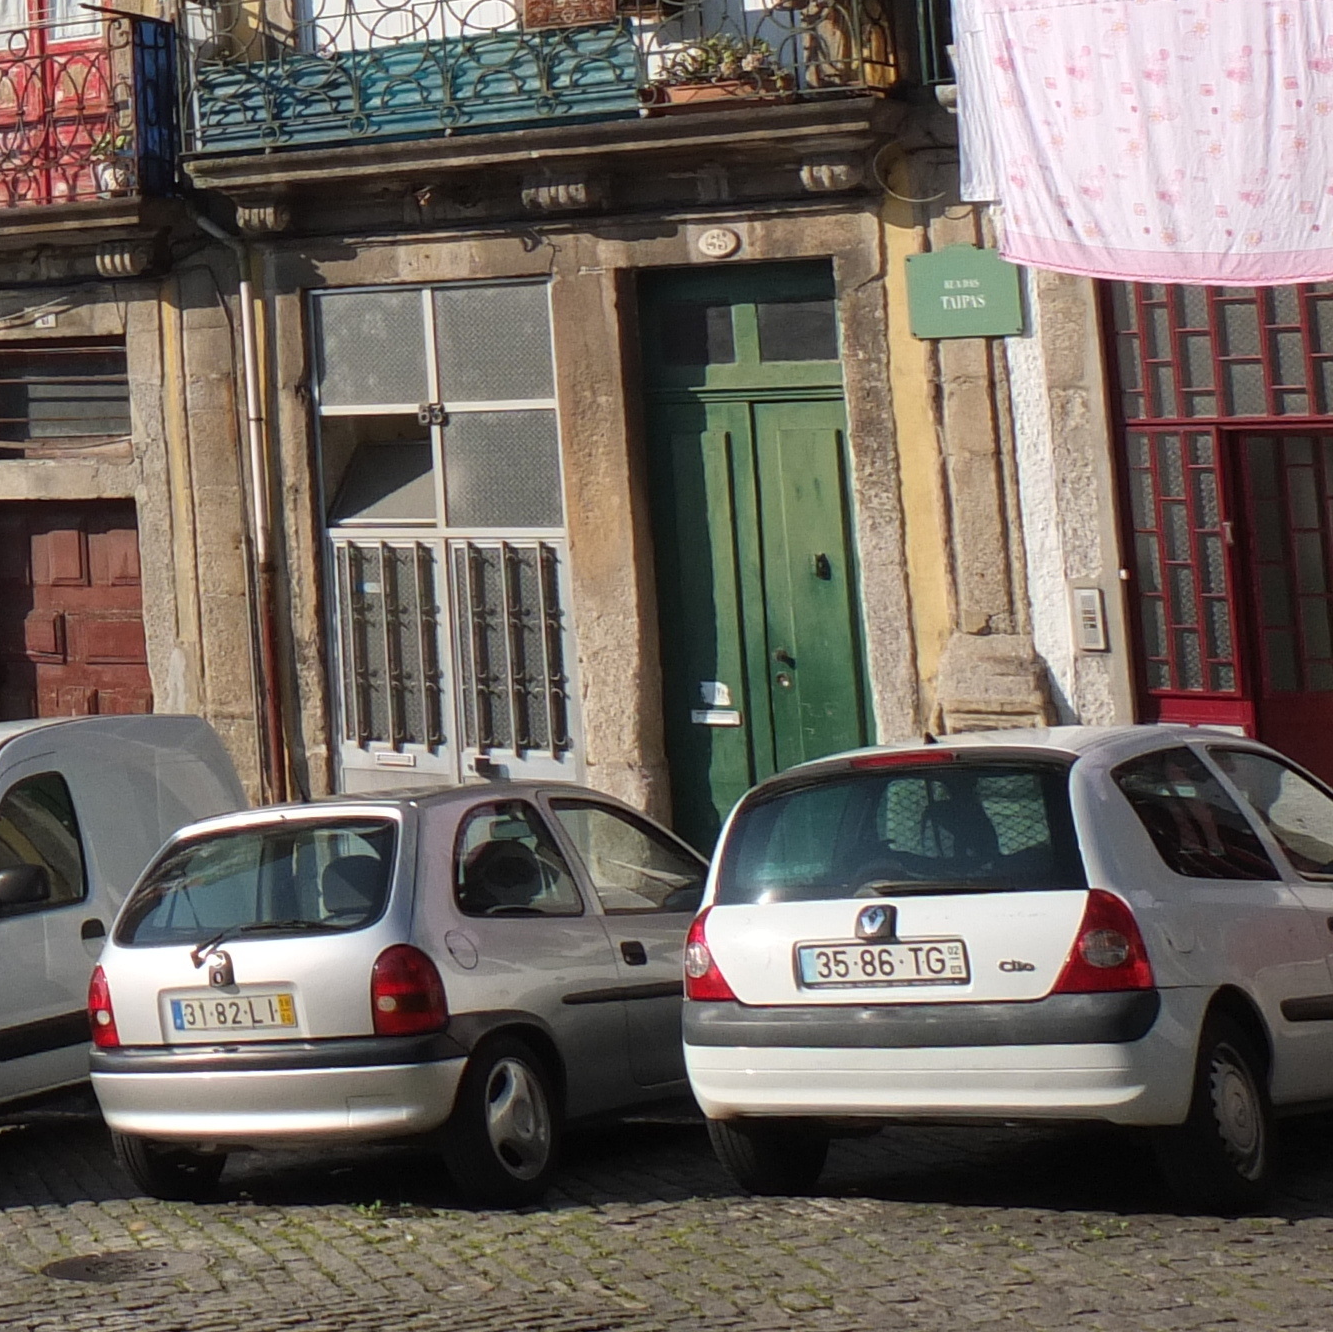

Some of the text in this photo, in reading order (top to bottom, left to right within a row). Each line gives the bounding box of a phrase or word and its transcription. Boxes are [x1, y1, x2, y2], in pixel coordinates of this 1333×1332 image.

[940, 294, 986, 310] TAIPAS
[418, 404, 444, 425] 63
[999, 960, 1036, 973] Clio
